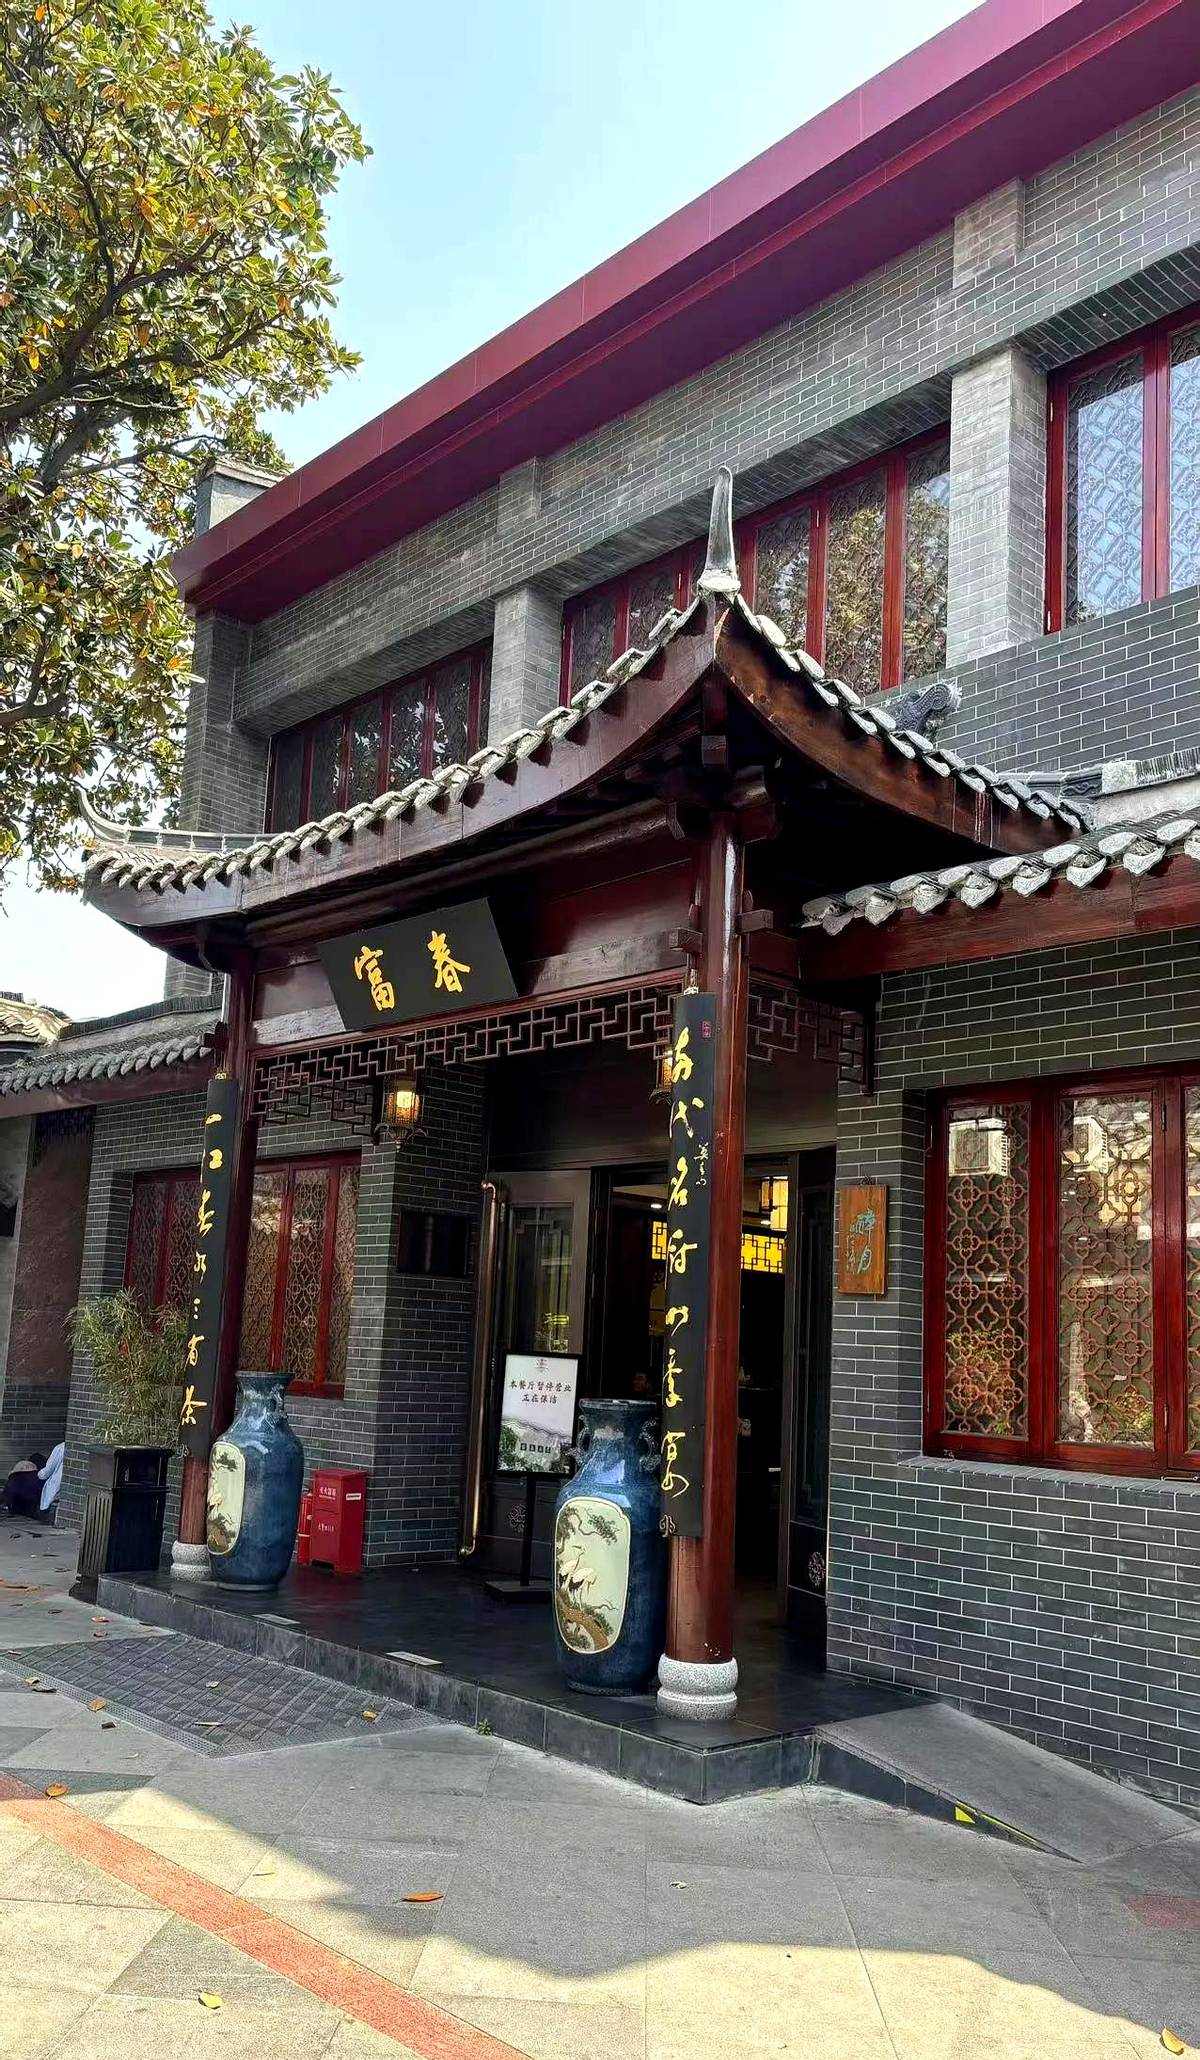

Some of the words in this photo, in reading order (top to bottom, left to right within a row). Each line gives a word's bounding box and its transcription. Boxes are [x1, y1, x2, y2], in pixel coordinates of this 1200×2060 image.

[353, 930, 471, 1011] 富春
[511, 1380, 572, 1391] 本餐厅暂停营业
